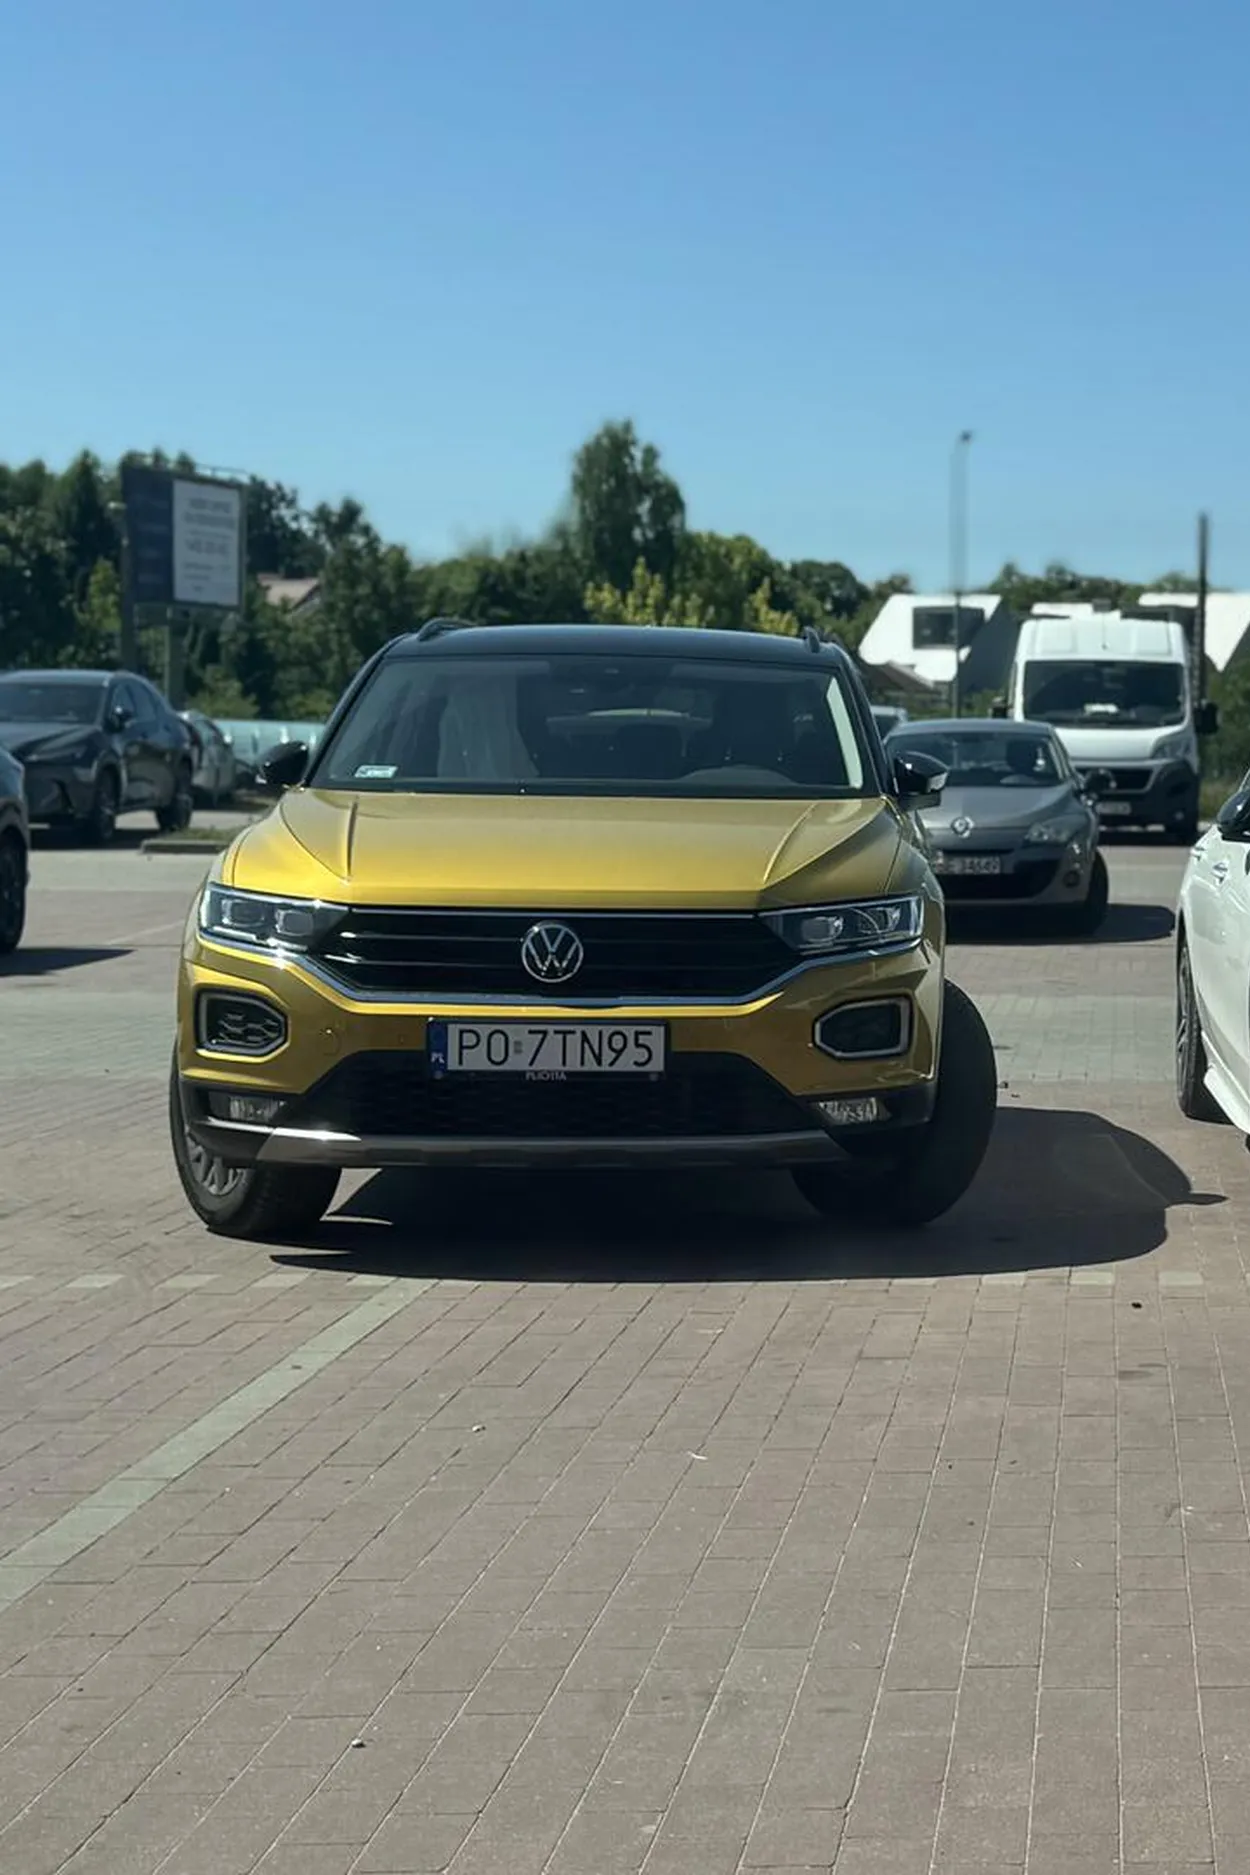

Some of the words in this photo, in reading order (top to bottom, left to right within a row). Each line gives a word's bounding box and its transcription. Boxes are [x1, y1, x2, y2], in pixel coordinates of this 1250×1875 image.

[524, 924, 581, 979] VW
[458, 1028, 510, 1066] PO
[528, 1030, 653, 1067] 7TN95
